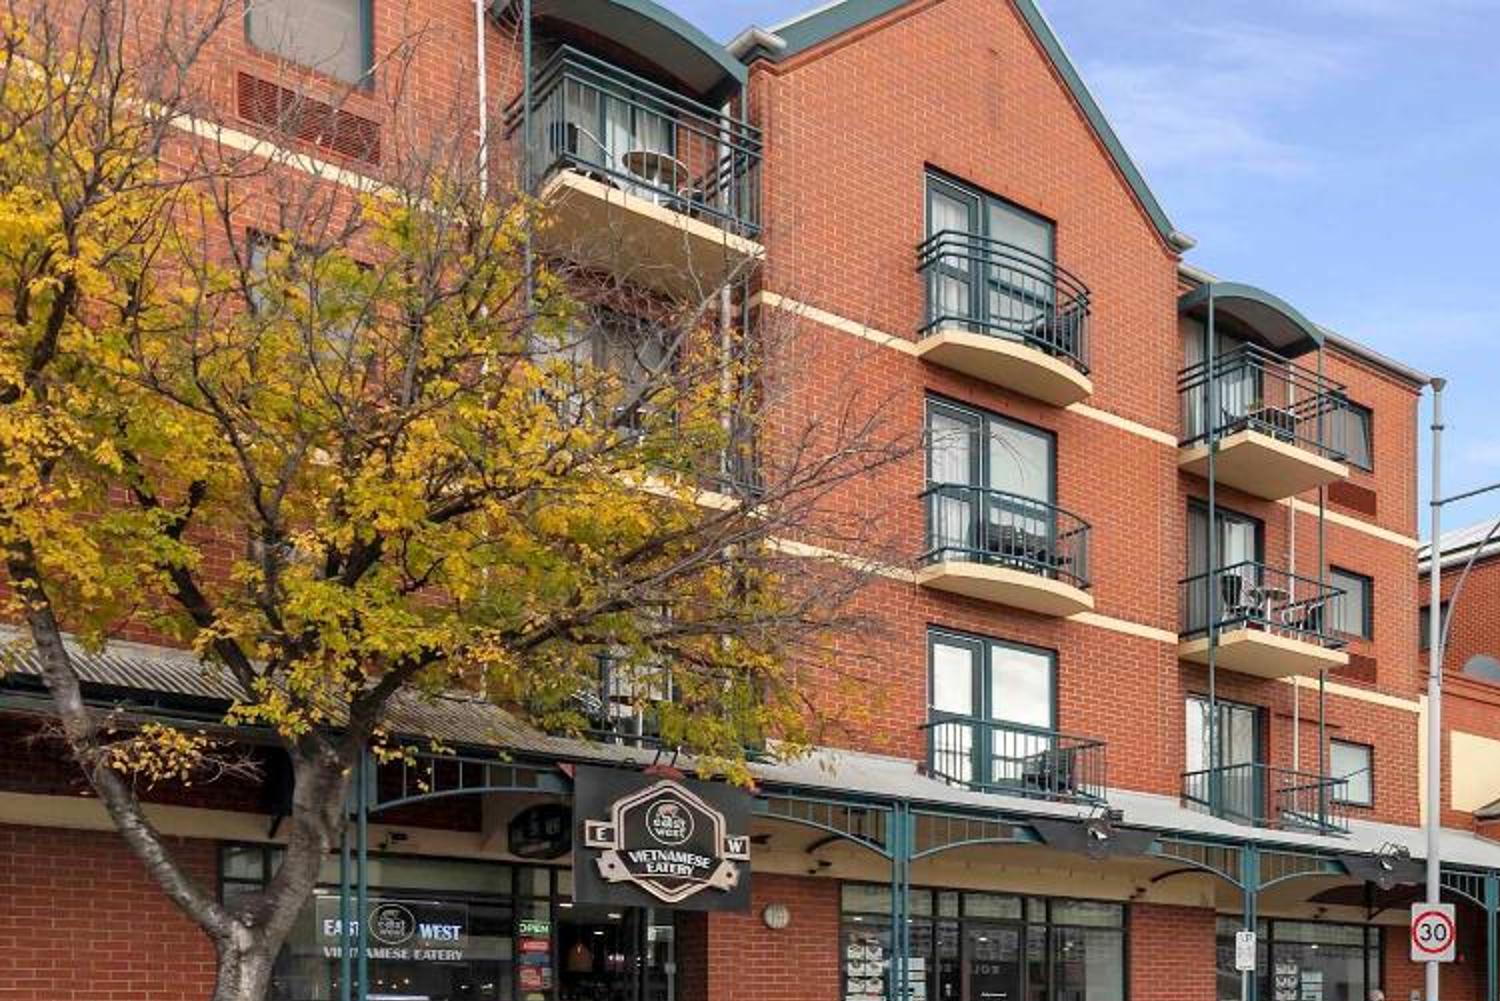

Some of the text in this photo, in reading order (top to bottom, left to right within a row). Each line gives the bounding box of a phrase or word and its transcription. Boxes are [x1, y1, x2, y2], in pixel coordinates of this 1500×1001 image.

[596, 827, 606, 841] E
[729, 839, 744, 853] W
[628, 850, 711, 869] VIETNAMESE
[647, 862, 695, 875] EATERY
[418, 923, 463, 941] WEST
[518, 922, 550, 934] OPEN
[1420, 923, 1447, 941] 30
[414, 949, 463, 961] EATERY
